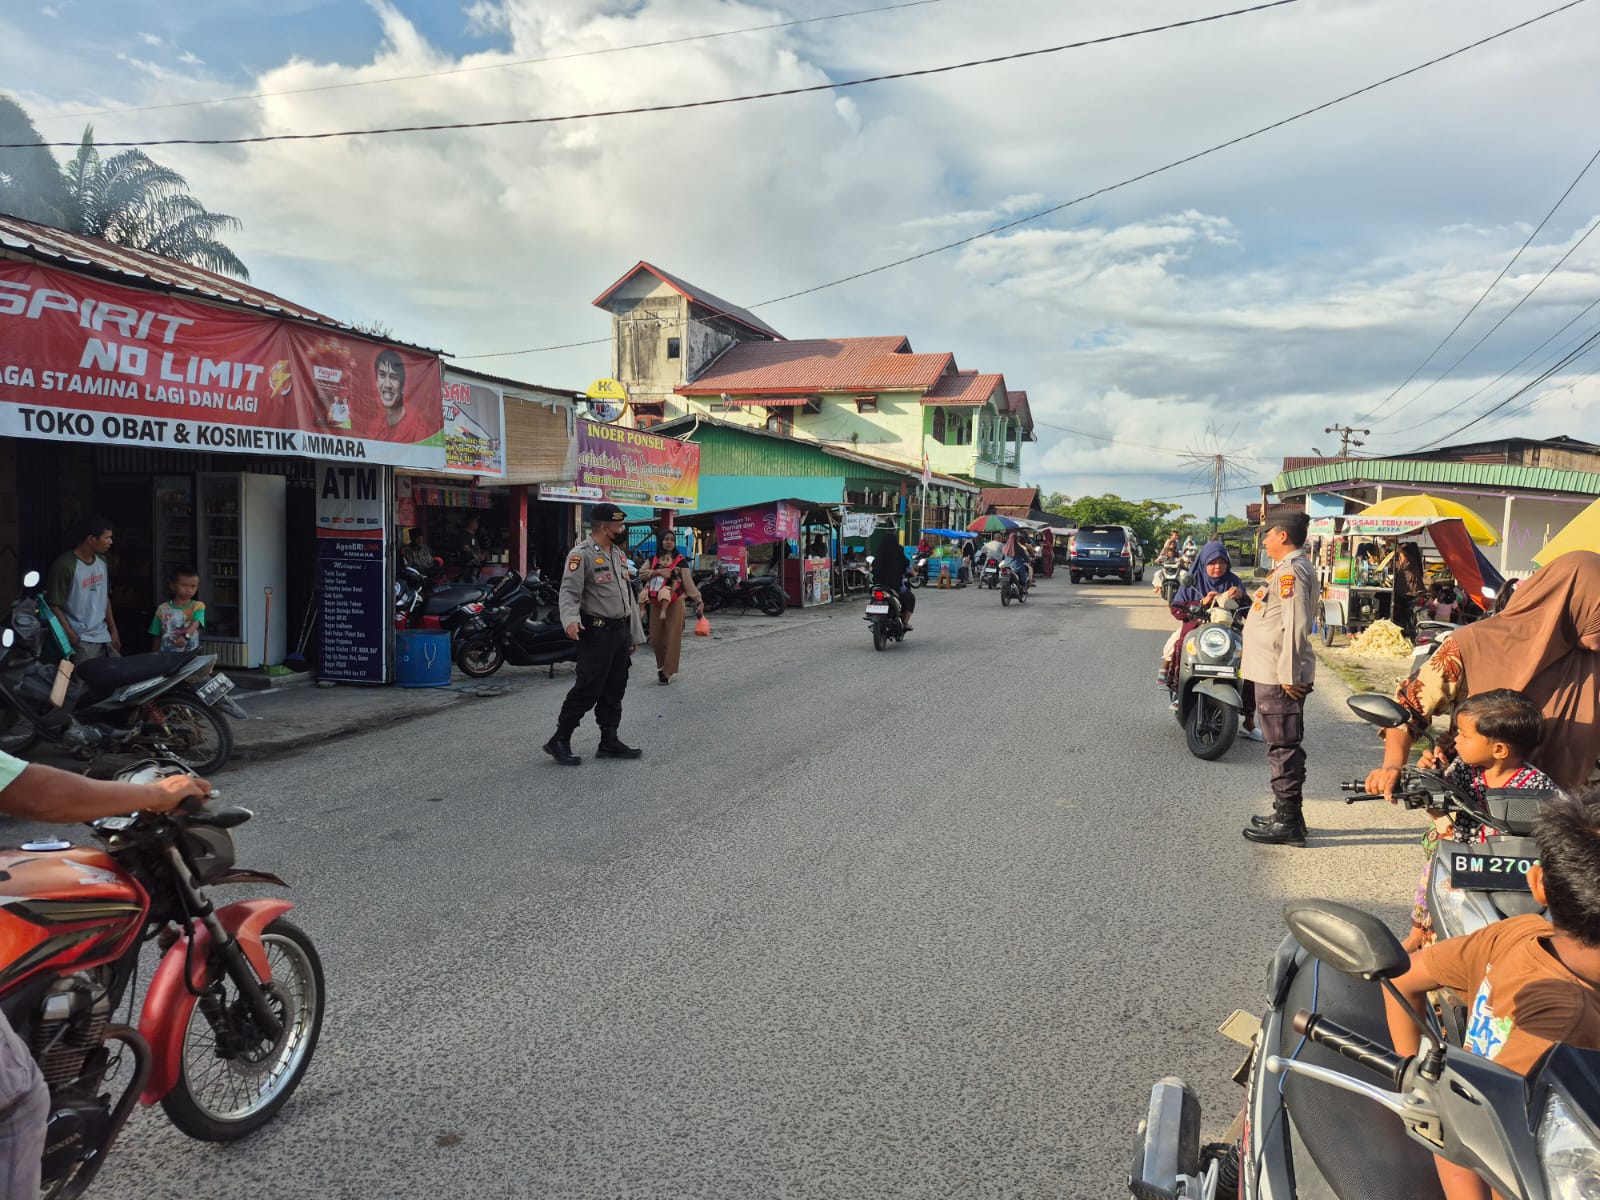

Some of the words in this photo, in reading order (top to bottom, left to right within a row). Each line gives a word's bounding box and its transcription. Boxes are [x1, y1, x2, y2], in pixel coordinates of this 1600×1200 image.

[0, 280, 195, 345] SPIRIT
[79, 337, 149, 376] NO
[160, 352, 265, 391] LIMIT
[0, 365, 36, 388] GA
[41, 370, 139, 400] STAMINA
[145, 383, 185, 405] LAGI
[189, 389, 224, 409] DAN
[227, 395, 259, 413] LAGI
[18, 407, 95, 437] TOKO
[102, 416, 168, 442] OBAT
[174, 422, 190, 444] &
[197, 425, 298, 451] KOSMETIK
[302, 434, 366, 458] AMMARA
[627, 432, 666, 451] PONSEL
[322, 467, 377, 500] ATM
[1455, 856, 1484, 872] BM
